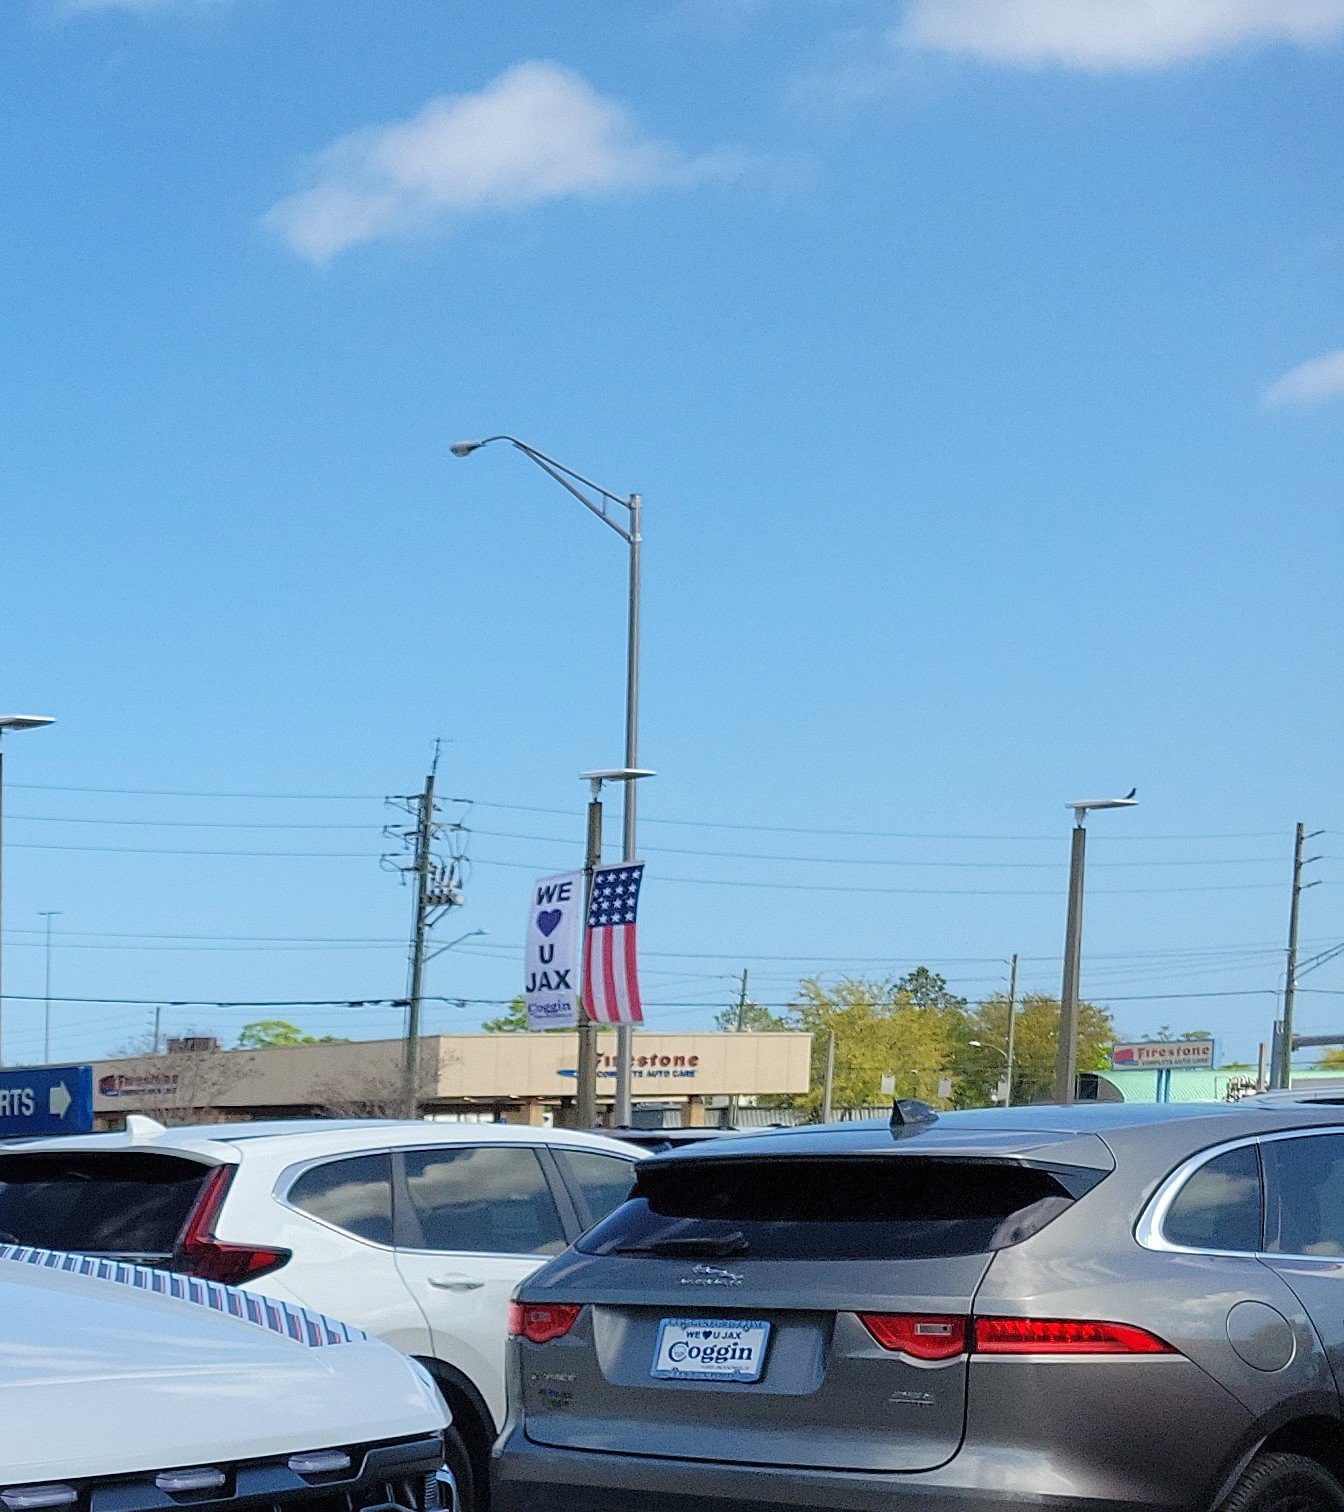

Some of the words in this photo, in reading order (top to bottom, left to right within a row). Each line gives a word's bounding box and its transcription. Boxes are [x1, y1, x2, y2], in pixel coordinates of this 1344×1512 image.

[536, 881, 573, 906] WE
[539, 943, 555, 965] U
[525, 968, 572, 993] JAX
[1137, 1046, 1210, 1059] Firestone
[685, 1330, 700, 1339] WE
[712, 1331, 721, 1339] U
[721, 1330, 742, 1340] JAX
[668, 1341, 753, 1364] Coggin
